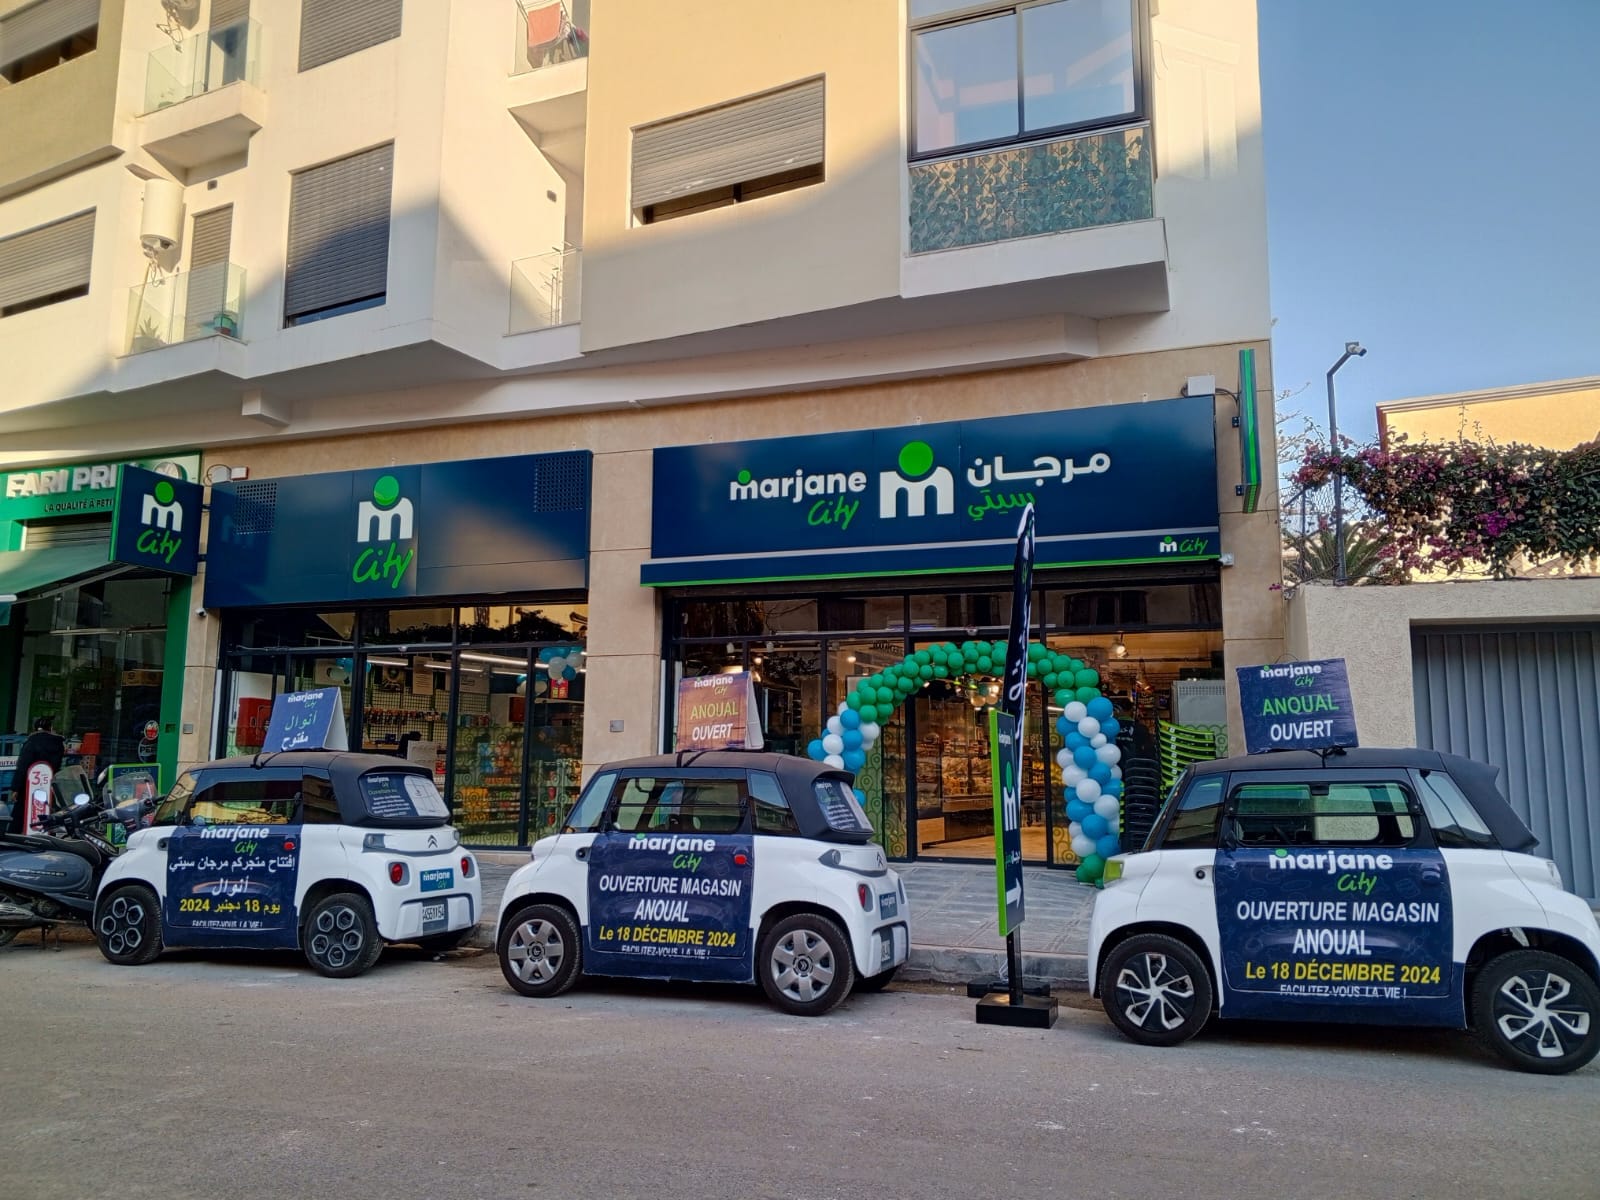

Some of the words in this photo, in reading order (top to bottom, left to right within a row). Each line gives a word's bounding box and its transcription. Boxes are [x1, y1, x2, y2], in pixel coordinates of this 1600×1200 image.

[6, 469, 69, 498] FARI
[72, 463, 118, 491] PRI
[967, 453, 1112, 488] مرجان
[730, 469, 867, 503] marjane
[96, 498, 114, 508] PETI
[967, 487, 1036, 521] سيتي
[807, 496, 860, 531] City
[136, 529, 182, 564] City
[1179, 537, 1209, 555] City
[352, 542, 414, 589] City
[1260, 664, 1322, 679] marjane
[1295, 676, 1315, 687] City
[694, 676, 734, 688] marjane
[288, 691, 323, 703] marjane
[1263, 694, 1340, 716] ANOUAL
[690, 702, 738, 720] ANOUAL
[281, 731, 309, 750] مفتوح
[692, 723, 734, 741] OUVERT
[1270, 720, 1333, 741] OUVERT
[201, 826, 270, 842] marjane
[628, 833, 716, 854] marjane
[234, 841, 258, 857] City
[169, 856, 195, 872] سيتي
[198, 856, 228, 870] مرجان
[231, 856, 266, 872] متجركم
[672, 853, 702, 872] City
[1269, 849, 1393, 874] marjane
[600, 875, 677, 893] OUVERTURE
[681, 879, 742, 897] MAGASIN
[1337, 872, 1378, 896] City
[180, 898, 210, 912] 2024
[244, 900, 260, 912] 18
[263, 903, 281, 916] يوم
[634, 898, 690, 923] ANOUAL
[1236, 901, 1347, 921] OUVERTURE
[1352, 902, 1440, 923] MAGASIN
[600, 926, 613, 941] Le
[617, 927, 631, 941] 18
[633, 924, 704, 945] DÉCEMBRE
[707, 931, 736, 947] 2024
[1292, 929, 1372, 955] ANOUAL
[1246, 962, 1266, 979] Le
[1271, 962, 1290, 980] 18
[1294, 959, 1395, 982] DÉCEMBRE
[1400, 966, 1441, 984] 2024
